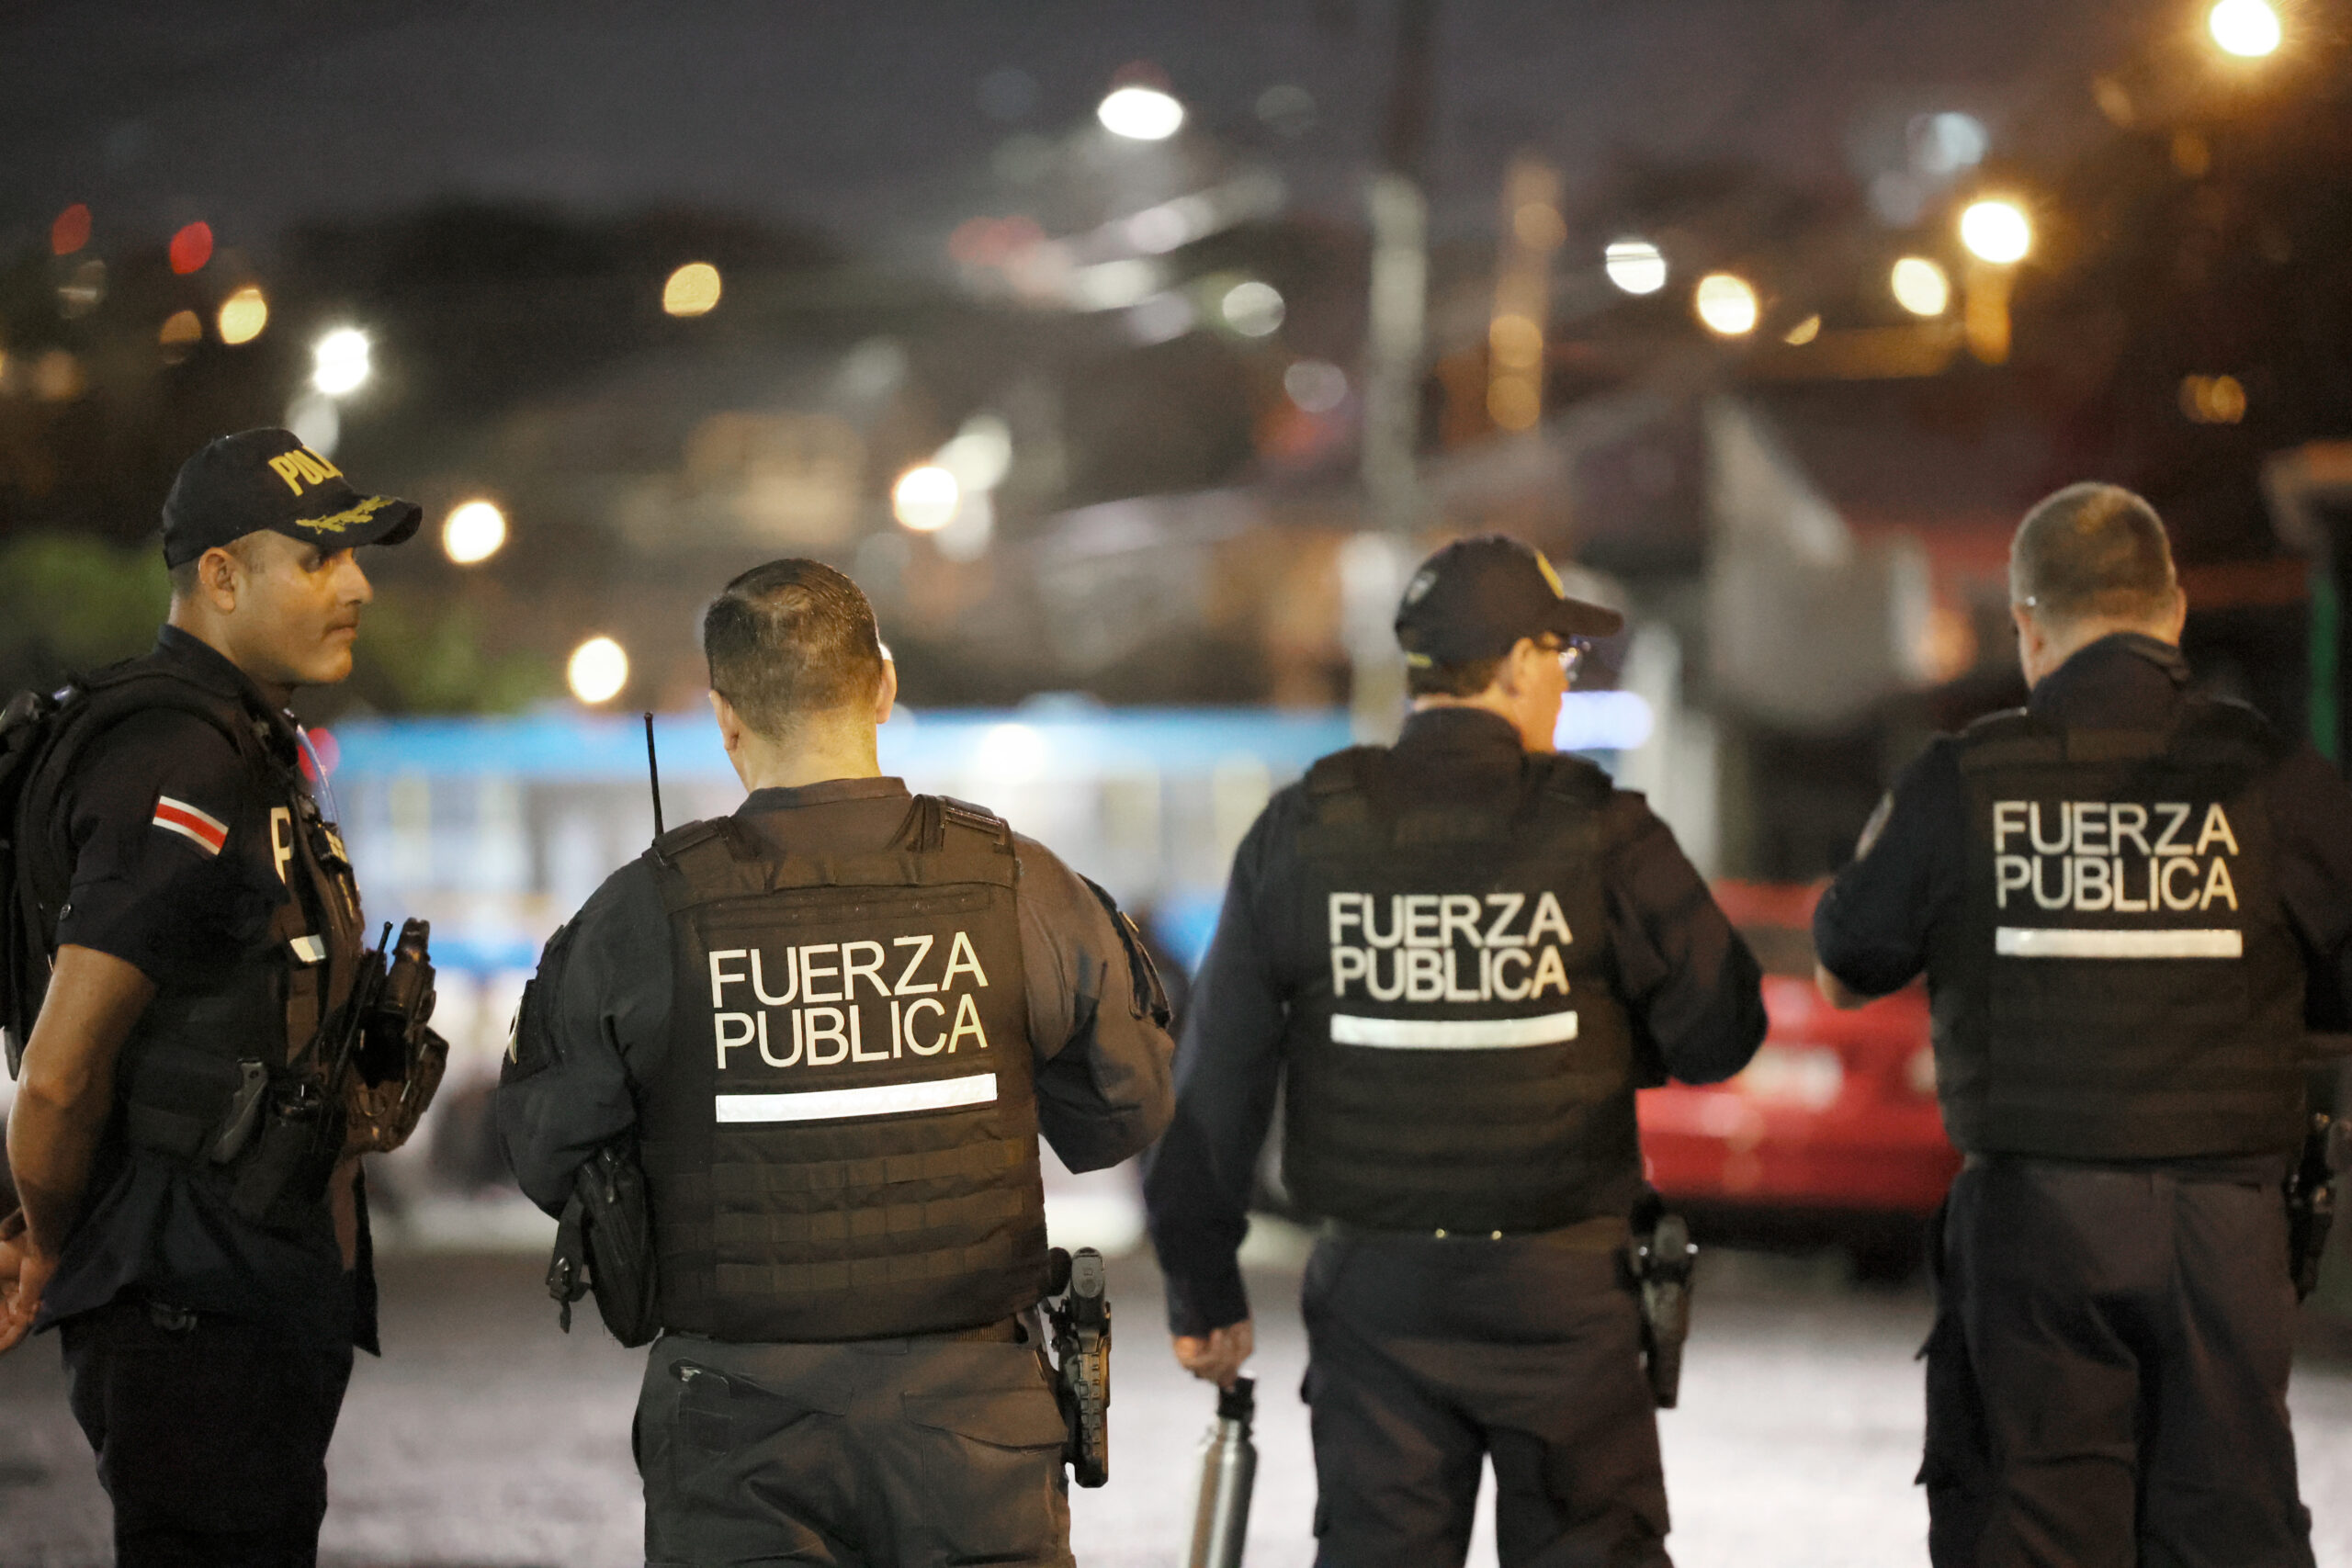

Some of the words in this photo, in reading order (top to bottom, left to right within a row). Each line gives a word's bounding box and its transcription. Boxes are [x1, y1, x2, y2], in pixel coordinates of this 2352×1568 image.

[1993, 801, 2239, 856] FUERZA
[1996, 855, 2238, 911] PUBLICA
[1329, 891, 1573, 948] FUERZA
[709, 931, 989, 1008] FUERZA
[1332, 945, 1570, 1001] PUBLICA
[714, 993, 989, 1069] PUBLICA
